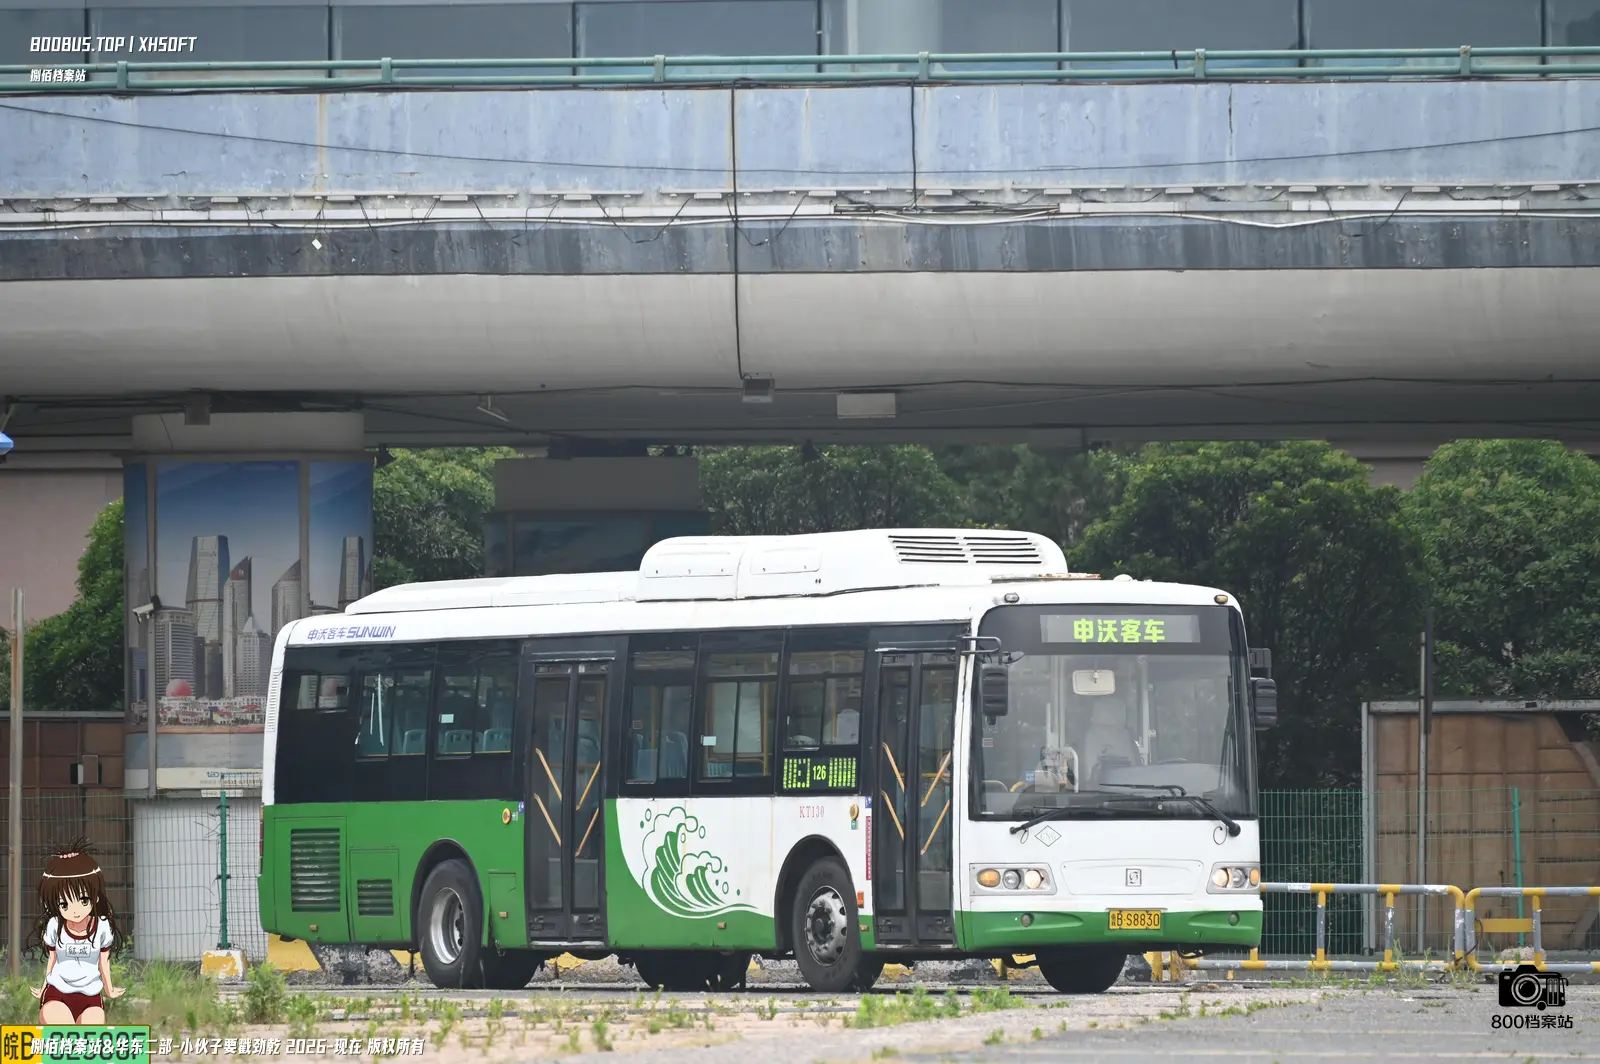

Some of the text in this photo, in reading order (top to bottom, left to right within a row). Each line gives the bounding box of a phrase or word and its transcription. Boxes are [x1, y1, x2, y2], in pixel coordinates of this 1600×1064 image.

[1073, 618, 1166, 643] 申沃客车
[812, 765, 827, 780] 126
[799, 805, 825, 819] KT130
